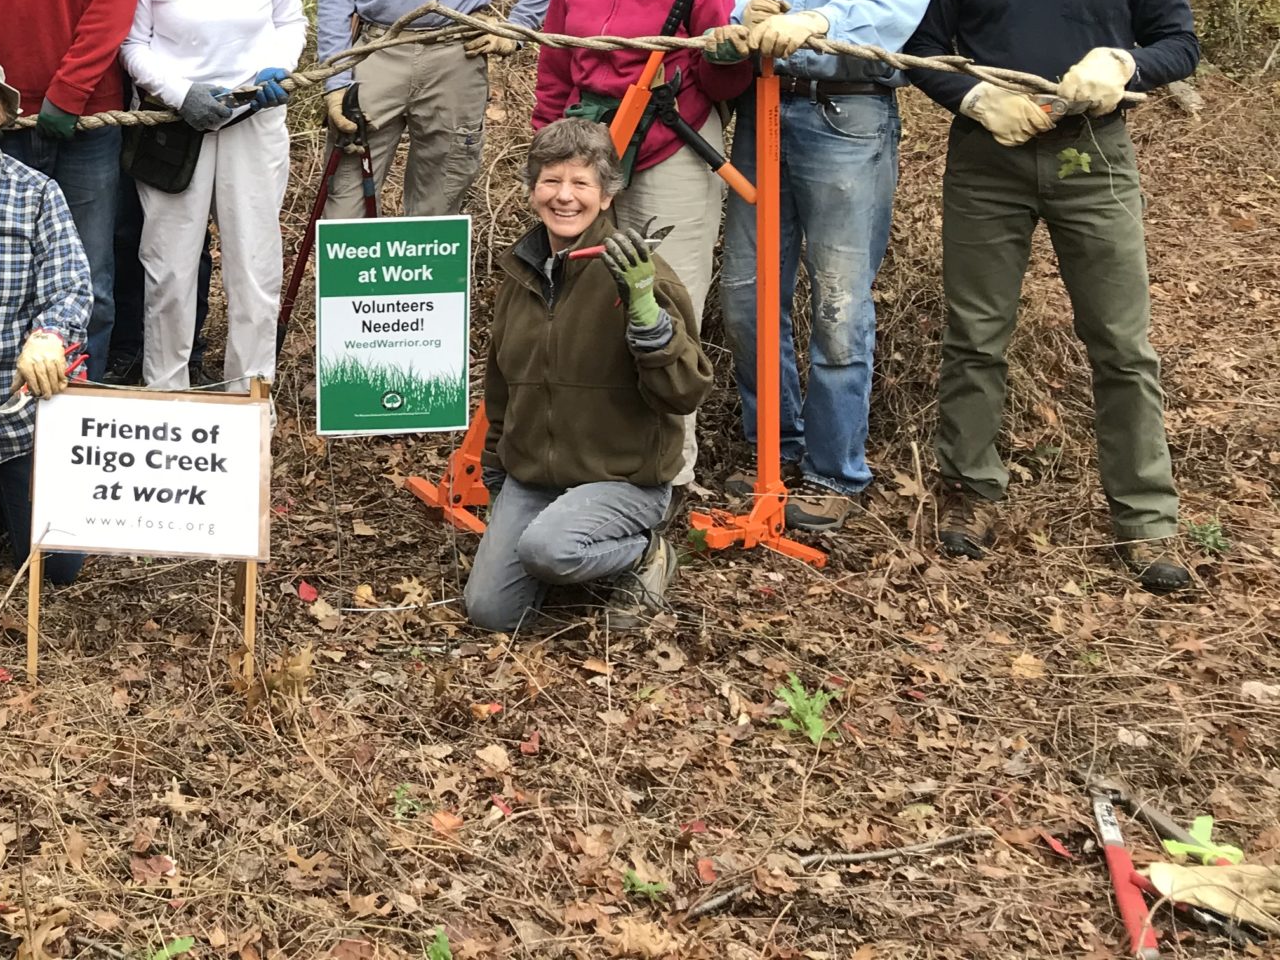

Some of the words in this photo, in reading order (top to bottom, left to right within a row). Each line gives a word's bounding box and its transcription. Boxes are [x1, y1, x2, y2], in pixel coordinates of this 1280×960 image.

[325, 242, 381, 259] Weed
[386, 239, 460, 257] Warrior
[358, 267, 377, 283] at
[382, 264, 433, 282] Work
[352, 299, 434, 314] Volunteers
[361, 318, 424, 333] Needed!
[344, 338, 442, 349] WeedWarrior.org
[81, 417, 182, 442] Friends
[191, 425, 220, 444] of
[70, 445, 135, 473] Sligo
[145, 449, 228, 473] Creek
[92, 481, 122, 501] at
[133, 485, 207, 505] work
[86, 516, 215, 535] www.fosc.org
